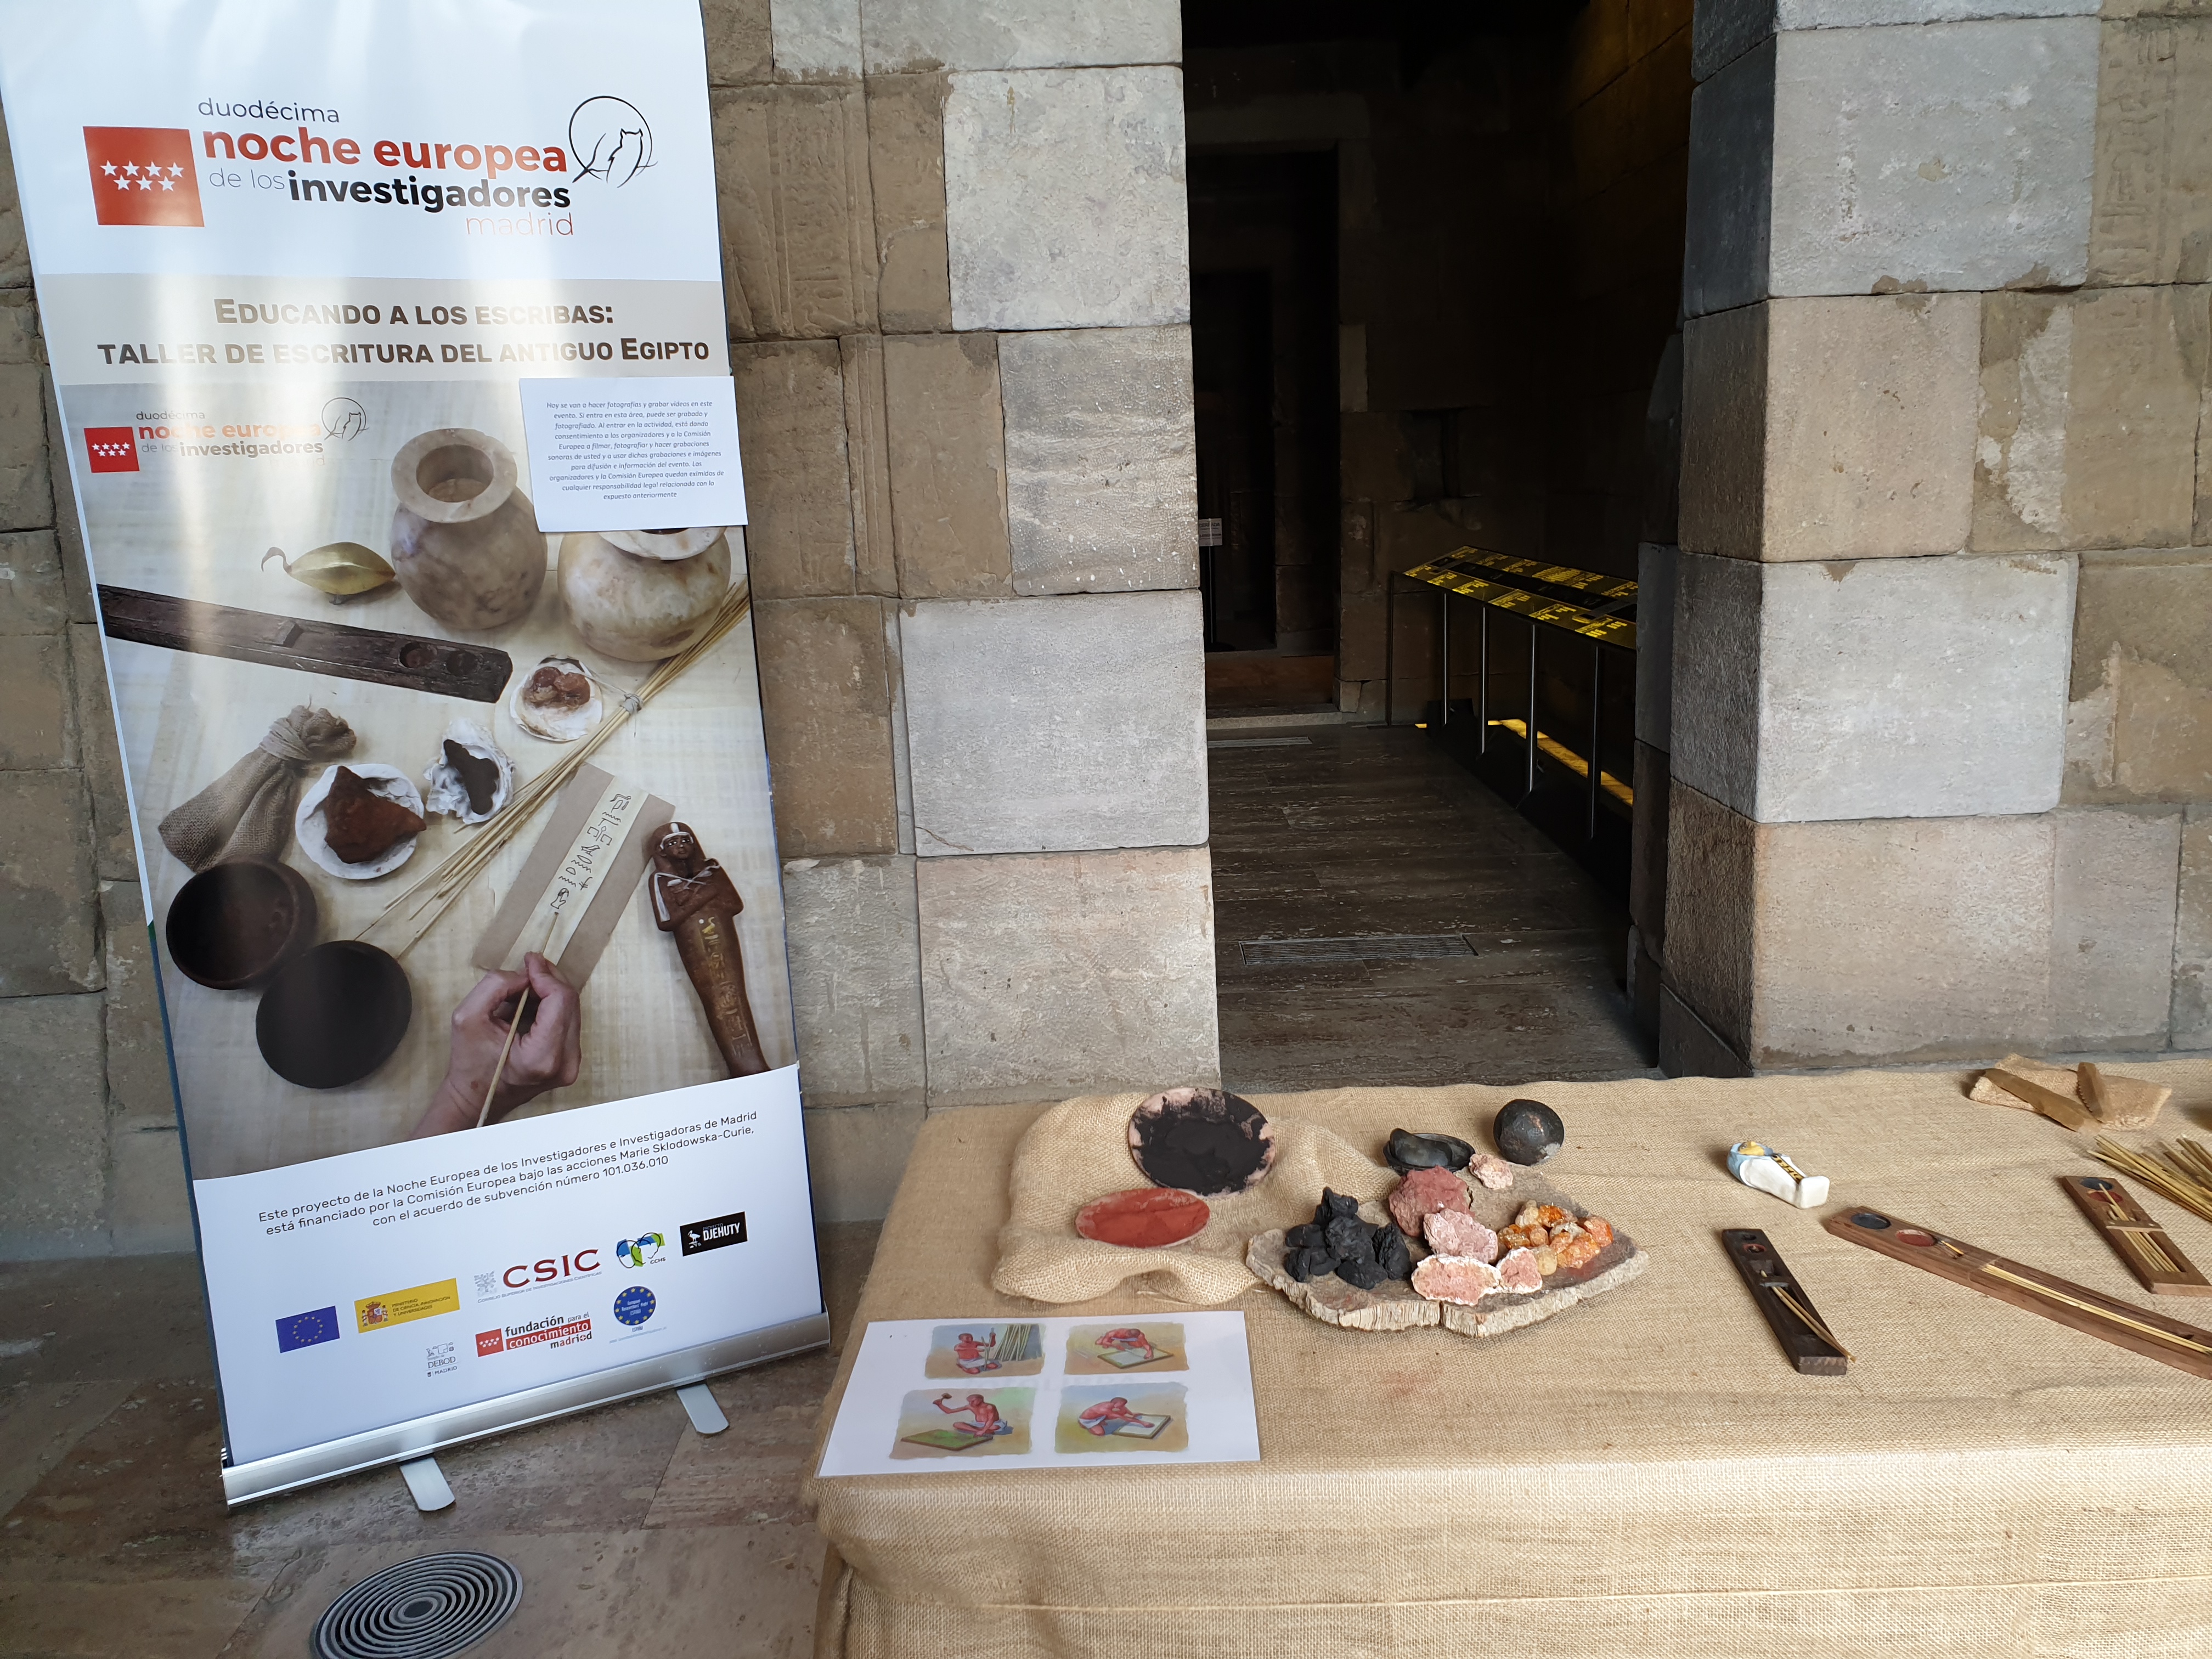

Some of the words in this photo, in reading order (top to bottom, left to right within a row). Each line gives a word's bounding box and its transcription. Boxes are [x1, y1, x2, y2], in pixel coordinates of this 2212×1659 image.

[198, 98, 340, 123] duodécima
[202, 126, 361, 164] noche
[373, 139, 567, 179] europea
[209, 168, 241, 188] de
[251, 170, 285, 190] los
[287, 170, 571, 213] investigadores
[466, 212, 574, 235] madrid
[390, 305, 409, 325] A
[415, 306, 467, 325] LOS
[475, 305, 613, 325] ESCRIBAS:
[97, 344, 217, 365] TALLER
[227, 344, 265, 364] DE
[273, 344, 434, 364] ESCRITURA
[441, 343, 492, 363] DEL
[499, 342, 613, 362] ANTIGUO
[136, 410, 205, 420] duodécima
[142, 443, 157, 453] de
[161, 442, 178, 453] los
[179, 440, 324, 459] investigadores
[258, 1209, 288, 1222] Este
[292, 1194, 350, 1217] proyecto
[354, 1191, 370, 1201] de
[373, 1188, 383, 1198] la
[387, 1180, 427, 1195] Noche
[430, 1169, 480, 1186] Europea
[483, 1164, 498, 1175] de
[501, 1159, 518, 1171] los
[521, 1141, 607, 1167] Investigadores
[610, 1141, 617, 1149] e
[619, 1122, 701, 1147] Investigadoras
[704, 1118, 718, 1129] de
[720, 1111, 757, 1127] Madrid
[266, 1221, 294, 1235] está
[298, 1206, 366, 1228] financiado
[369, 1201, 390, 1215] por
[393, 1198, 403, 1207] la
[407, 1185, 464, 1205] Comisión
[467, 1176, 516, 1192] Europea
[520, 1168, 544, 1182] bajo
[547, 1164, 563, 1176] las
[567, 1154, 617, 1172] acciones
[620, 1146, 650, 1160] Marie
[653, 1125, 754, 1153] Sklodowska-Curie,
[373, 1214, 396, 1227] con
[399, 1210, 410, 1220] el
[414, 1199, 463, 1218] acuerdo
[466, 1195, 481, 1206] de
[484, 1180, 552, 1203] subvención
[555, 1169, 600, 1188] número
[602, 1155, 669, 1177] 101.036.010
[703, 1222, 740, 1241] DJEHUTY
[503, 1249, 601, 1288] CSIC
[505, 1315, 565, 1338] fundación
[568, 1315, 582, 1324] para
[509, 1322, 589, 1350] conocimiento
[428, 1356, 456, 1368] DEBOD
[435, 1366, 458, 1375] MADRID
